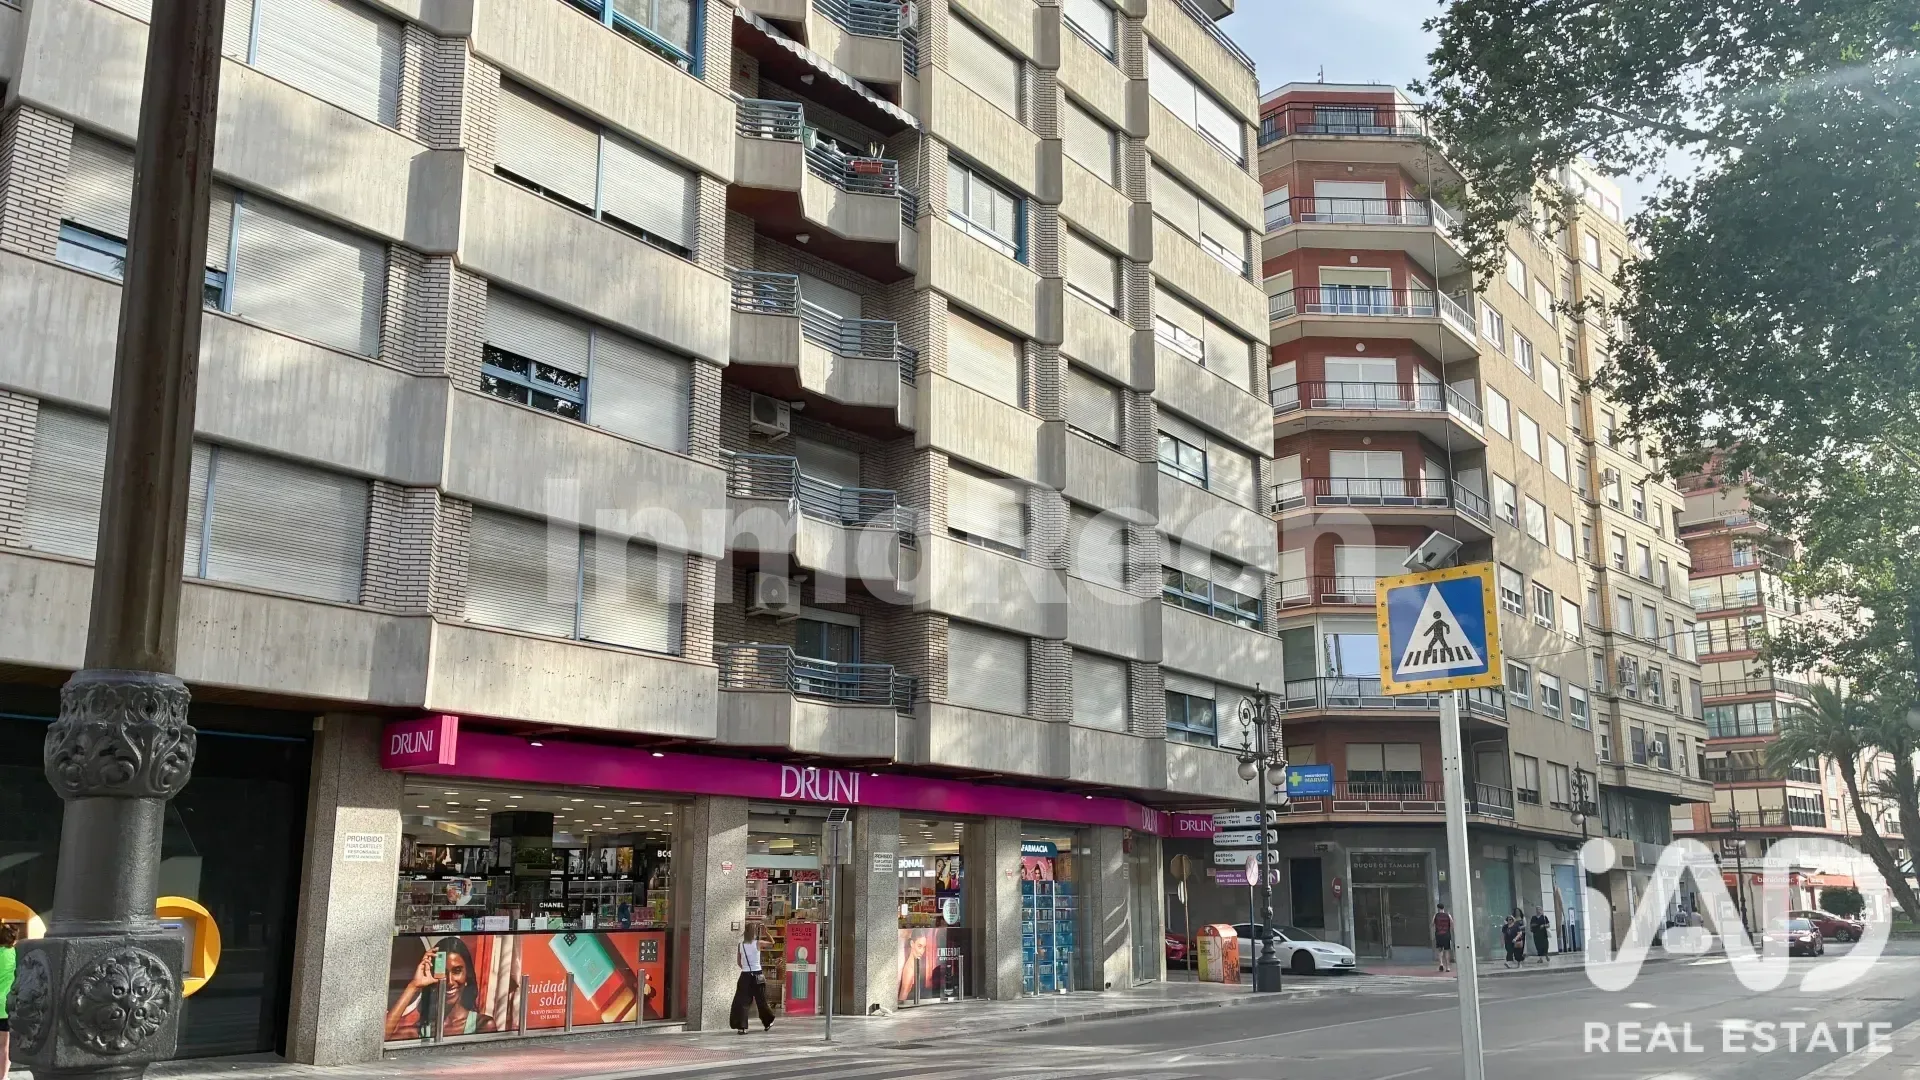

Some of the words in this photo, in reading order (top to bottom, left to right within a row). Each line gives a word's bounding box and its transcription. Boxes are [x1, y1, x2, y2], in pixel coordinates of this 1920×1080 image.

[391, 730, 434, 755] DRUNI
[780, 765, 860, 804] DRUNI
[346, 835, 383, 843] PROHIBIDO
[528, 979, 567, 994] uidad
